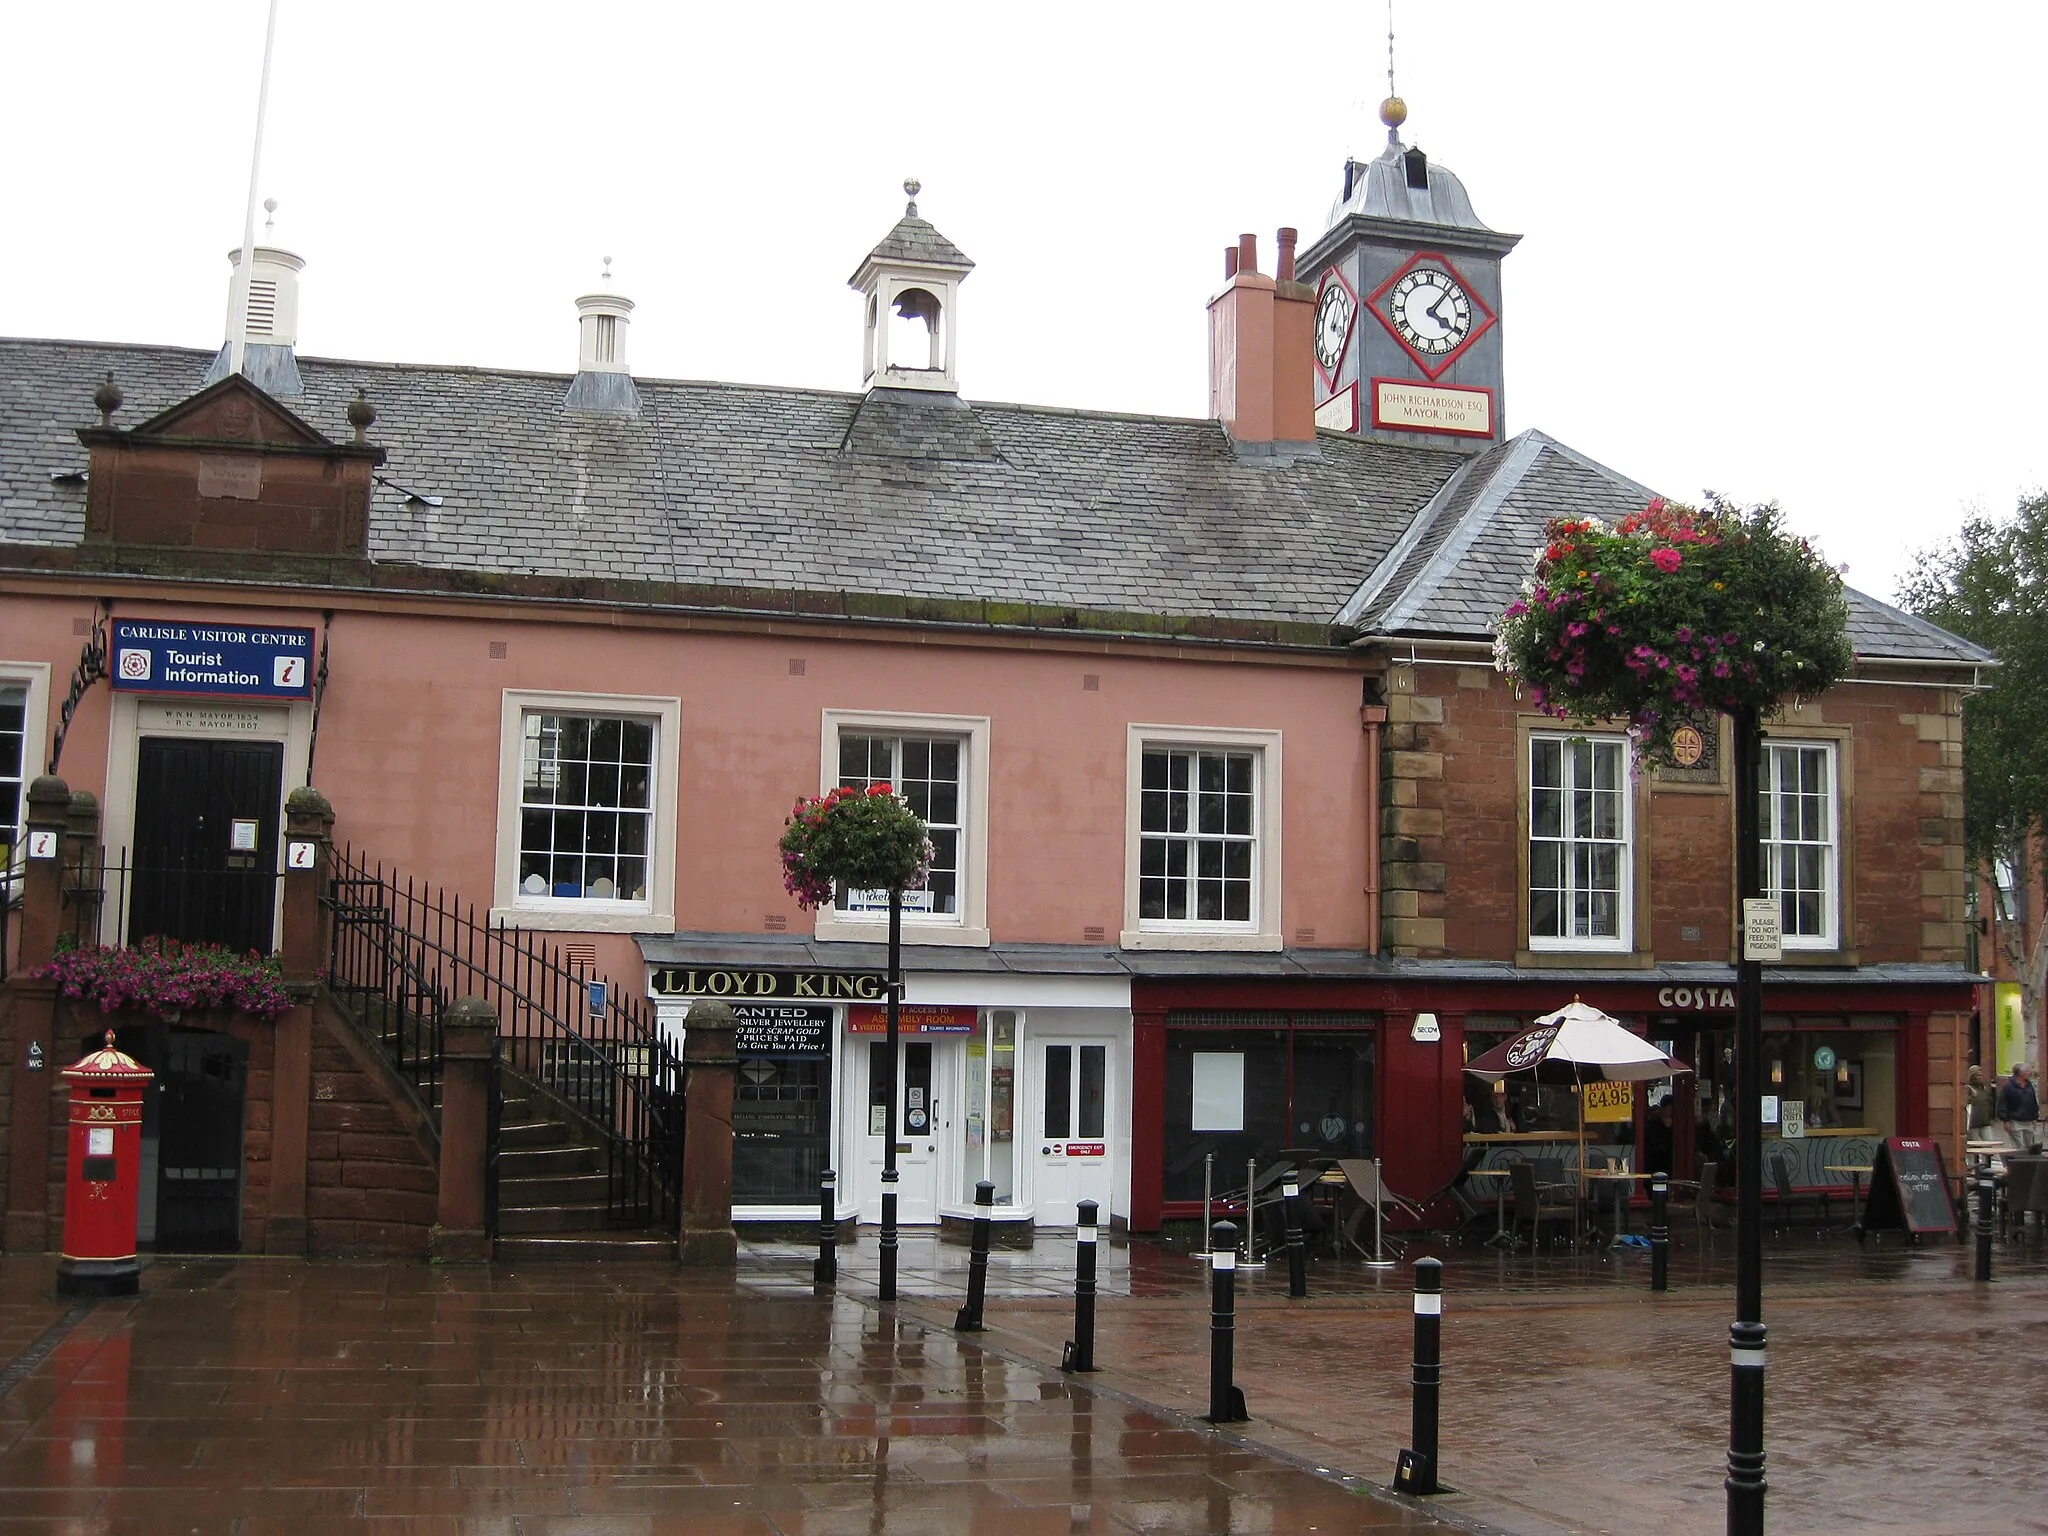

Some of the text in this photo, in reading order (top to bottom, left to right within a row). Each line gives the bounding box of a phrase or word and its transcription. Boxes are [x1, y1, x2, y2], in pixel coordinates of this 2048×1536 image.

[1383, 393, 1406, 404] JOHN
[1408, 395, 1463, 410] RICHARDSON
[1445, 411, 1466, 422] 1800
[120, 626, 306, 646] CARLISLE VISITOR CENTRE
[166, 650, 222, 667] Tourist
[165, 667, 259, 686] Information
[662, 970, 879, 999] LLOYD KING
[1658, 987, 1736, 1010] COSTA
[740, 1018, 826, 1028] SILVER JEWELLERY
[926, 1015, 955, 1024] ROOM
[743, 1034, 779, 1042] PRICES
[746, 1027, 764, 1035] BUY
[750, 1042, 769, 1050] Give
[772, 1042, 786, 1050] You
[29, 1059, 43, 1068] WC
[1588, 1088, 1630, 1109] £4.95
